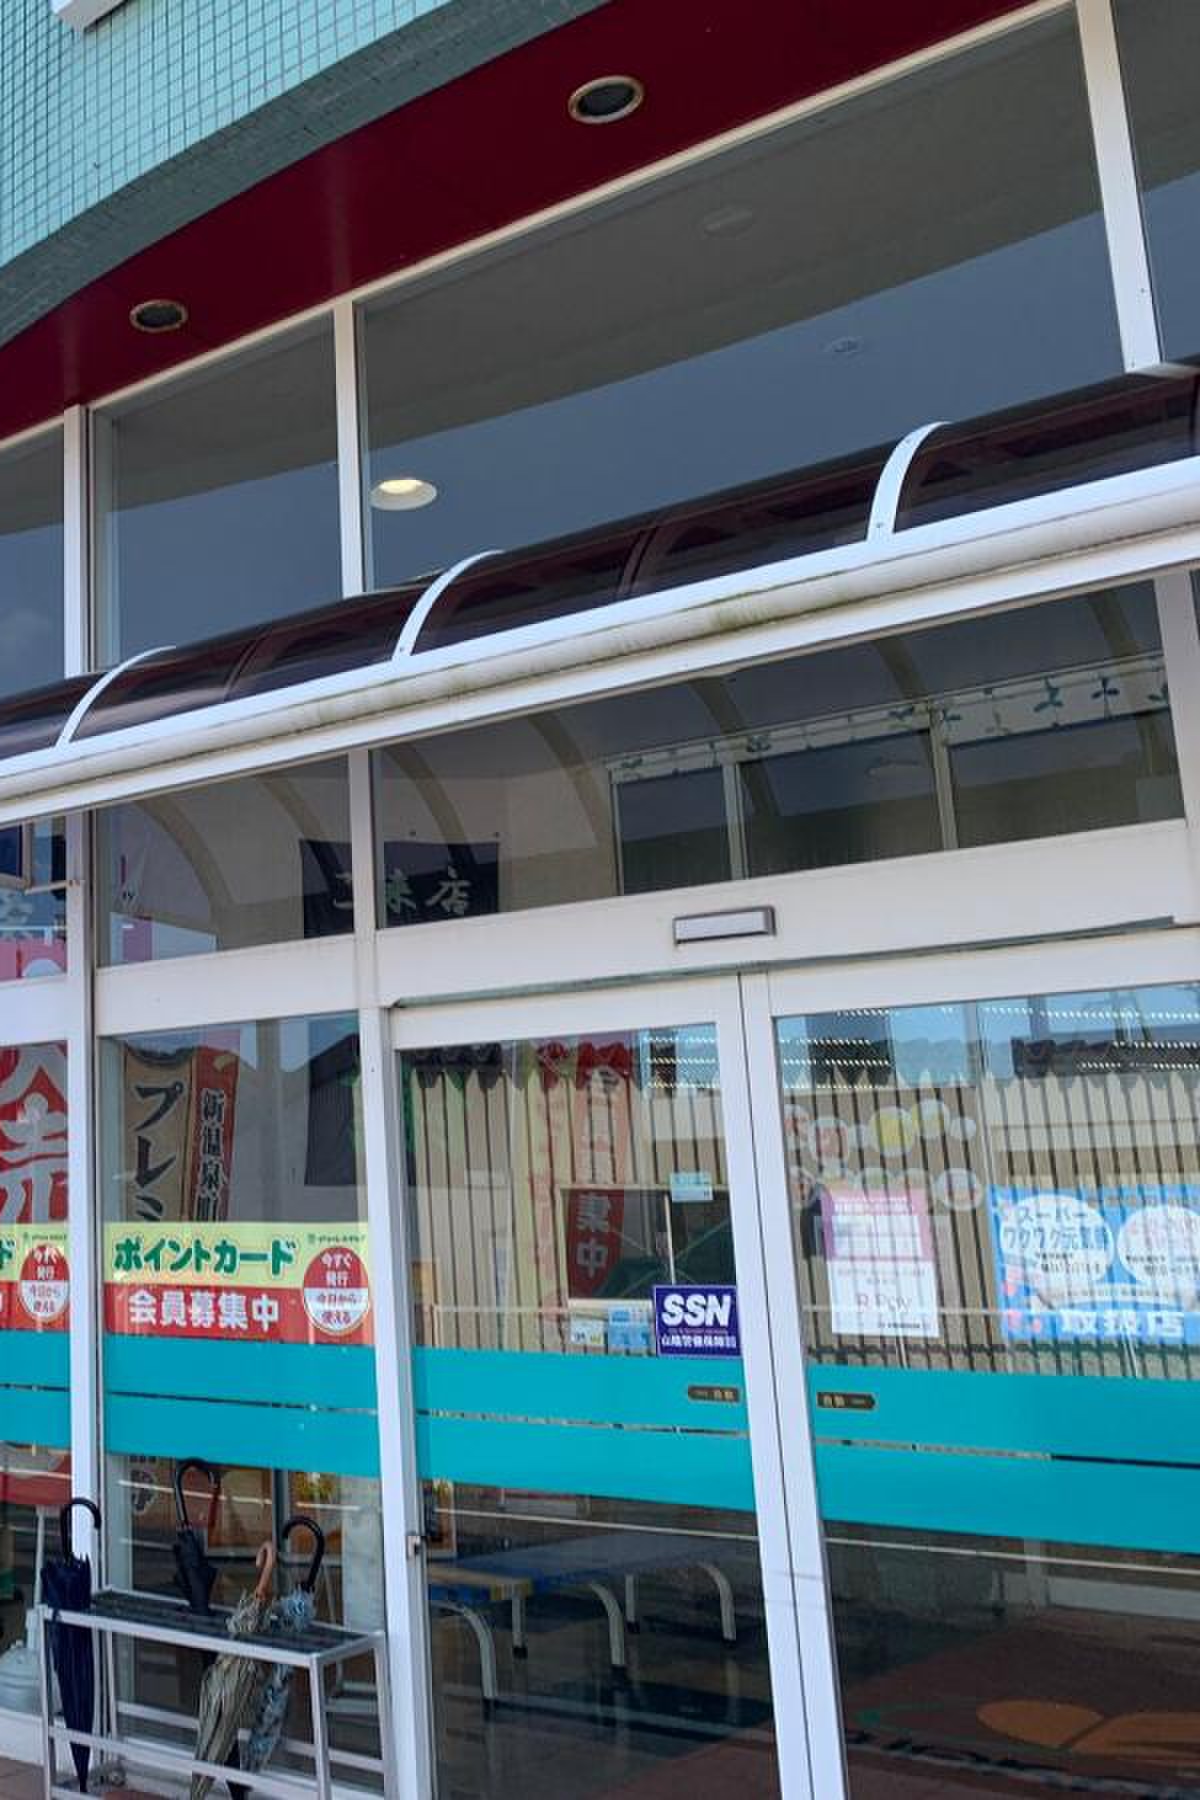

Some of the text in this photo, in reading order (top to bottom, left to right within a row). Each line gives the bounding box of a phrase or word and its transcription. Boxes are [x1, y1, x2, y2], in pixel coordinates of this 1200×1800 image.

[114, 1237, 296, 1276] ポイントカード
[128, 1289, 280, 1332] 会員募集中
[661, 1293, 732, 1328] SSN
